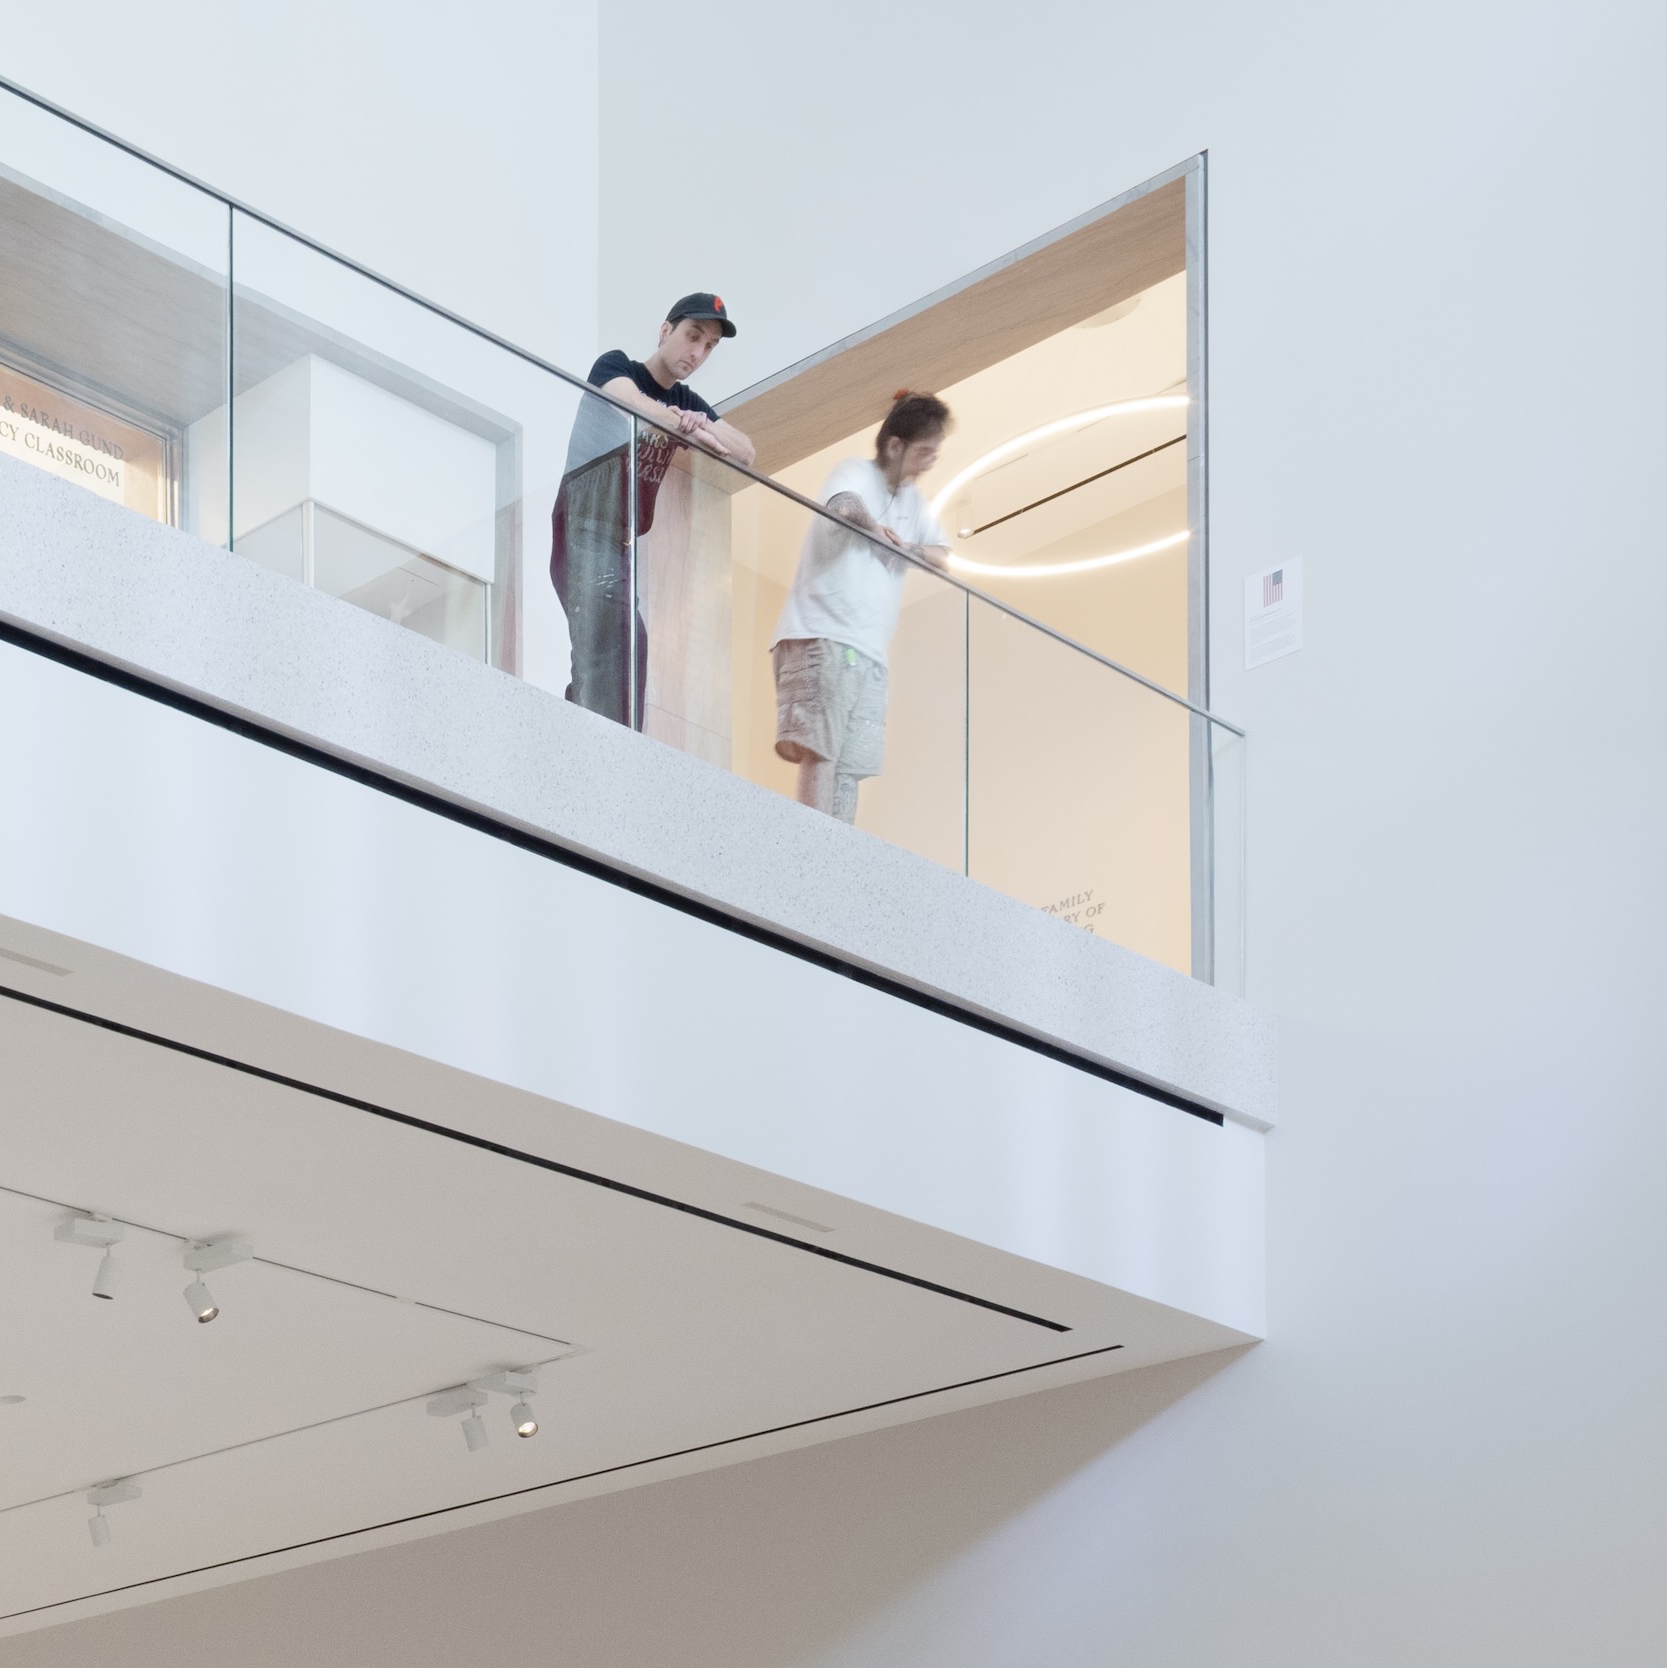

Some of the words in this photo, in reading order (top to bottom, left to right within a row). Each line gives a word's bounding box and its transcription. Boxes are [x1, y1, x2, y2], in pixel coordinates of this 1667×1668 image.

[3, 396, 16, 413] &
[21, 403, 73, 439] SARAH
[79, 431, 123, 460] GUND
[24, 432, 120, 486] CLASSROOM
[1086, 903, 1105, 917] OF
